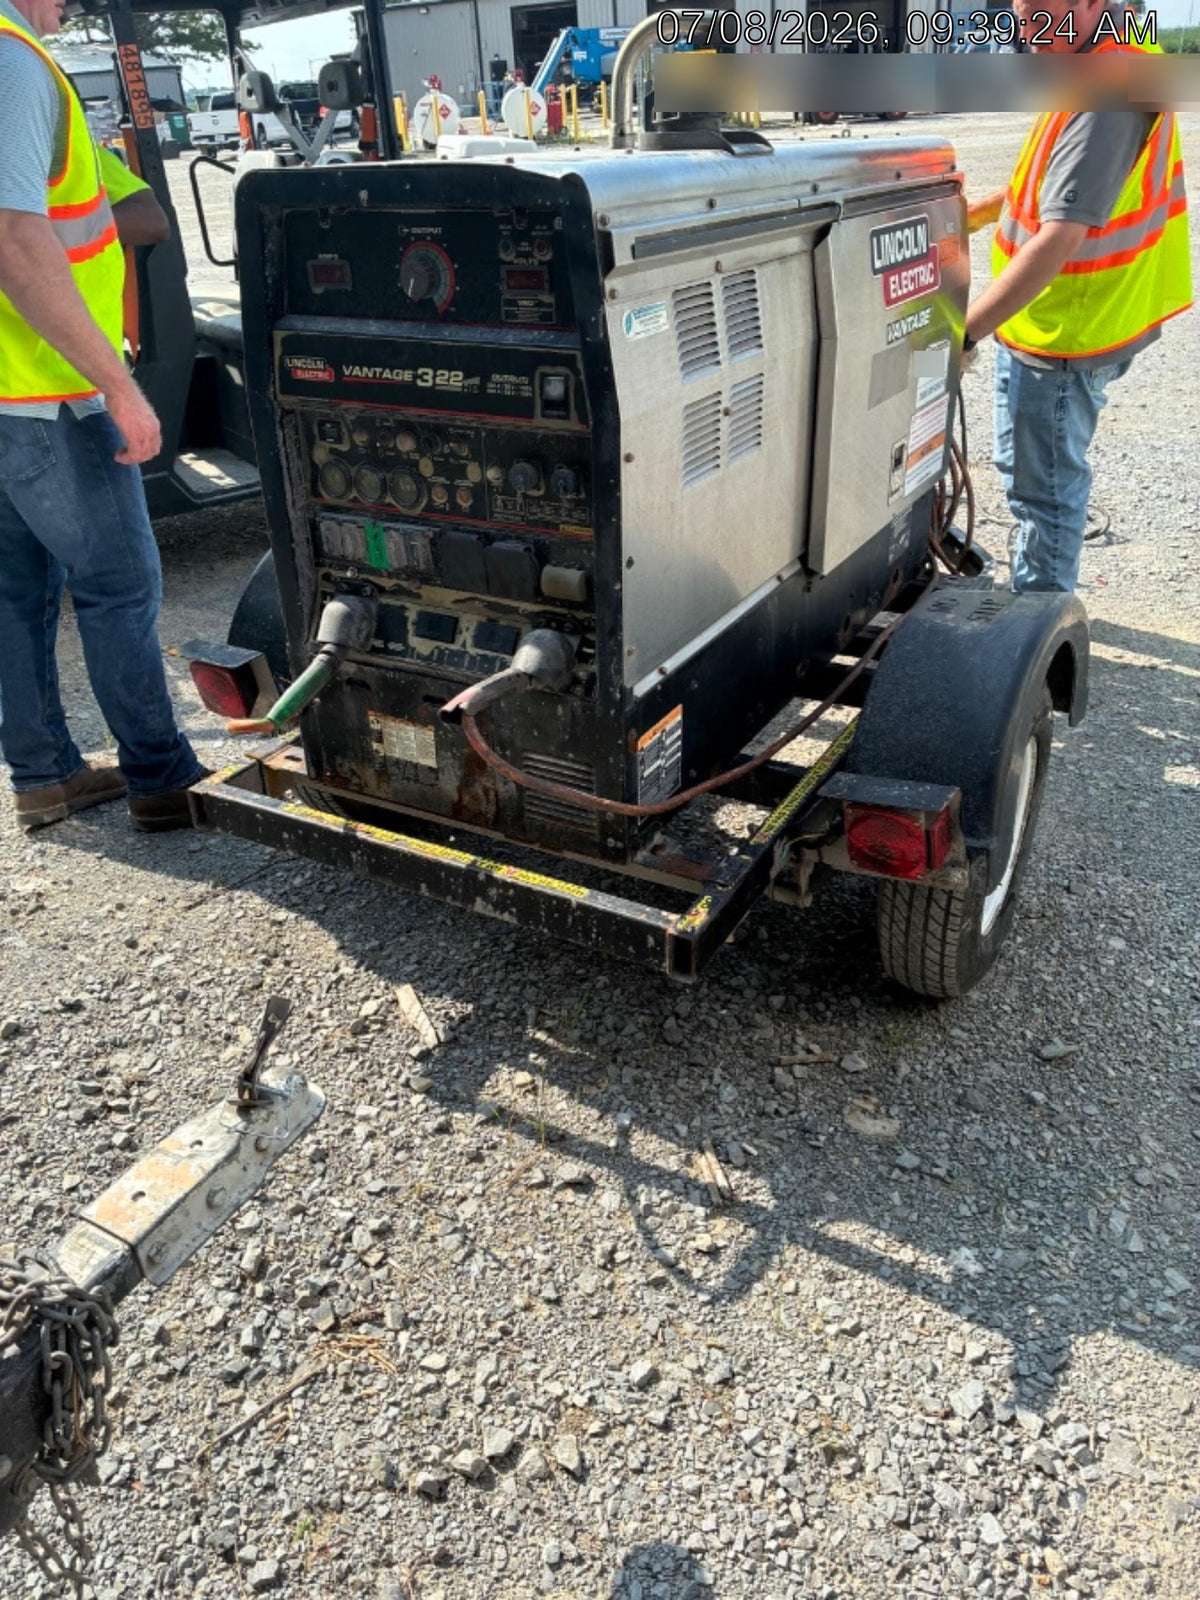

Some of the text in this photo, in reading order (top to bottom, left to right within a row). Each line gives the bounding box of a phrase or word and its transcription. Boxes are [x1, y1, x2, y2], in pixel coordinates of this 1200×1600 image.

[124, 47, 155, 126] 481895
[872, 223, 927, 269] LINCOLN
[889, 261, 934, 299] ELECTRIC
[887, 306, 931, 343] VANTAGE
[286, 357, 325, 369] LINCOLN
[294, 369, 331, 380] ELECTRIC
[341, 364, 414, 381] VANTAGE
[416, 367, 464, 388] 322
